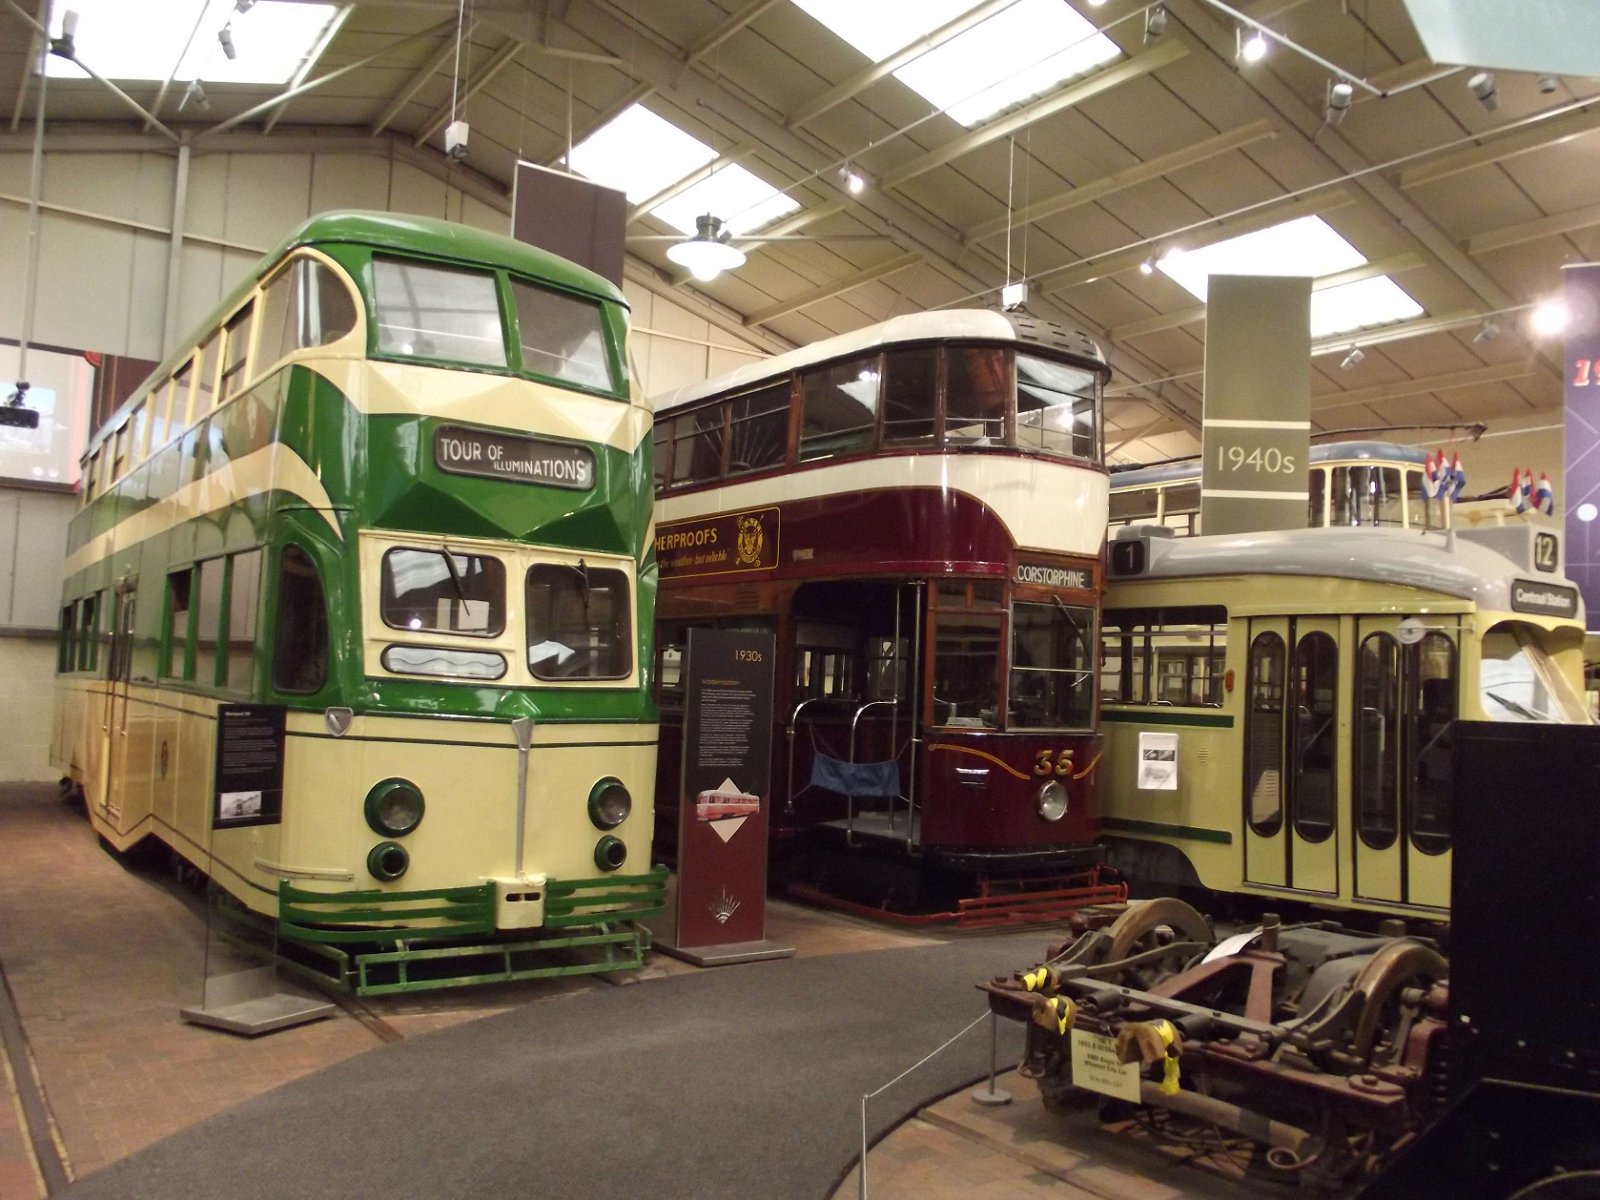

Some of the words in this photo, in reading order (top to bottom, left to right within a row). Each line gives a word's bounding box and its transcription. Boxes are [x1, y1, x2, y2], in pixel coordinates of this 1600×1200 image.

[440, 438, 482, 460] TOUR
[487, 444, 504, 460] OF
[1218, 446, 1295, 474] 1940s
[493, 459, 586, 482] ILLUMINATIONS
[655, 527, 718, 551] HERPROOFS
[1536, 535, 1553, 566] 12
[1125, 543, 1135, 569] 1
[1017, 564, 1085, 589] CORSTORPHINE
[735, 649, 763, 662] 1930s
[1033, 749, 1074, 776] 35
